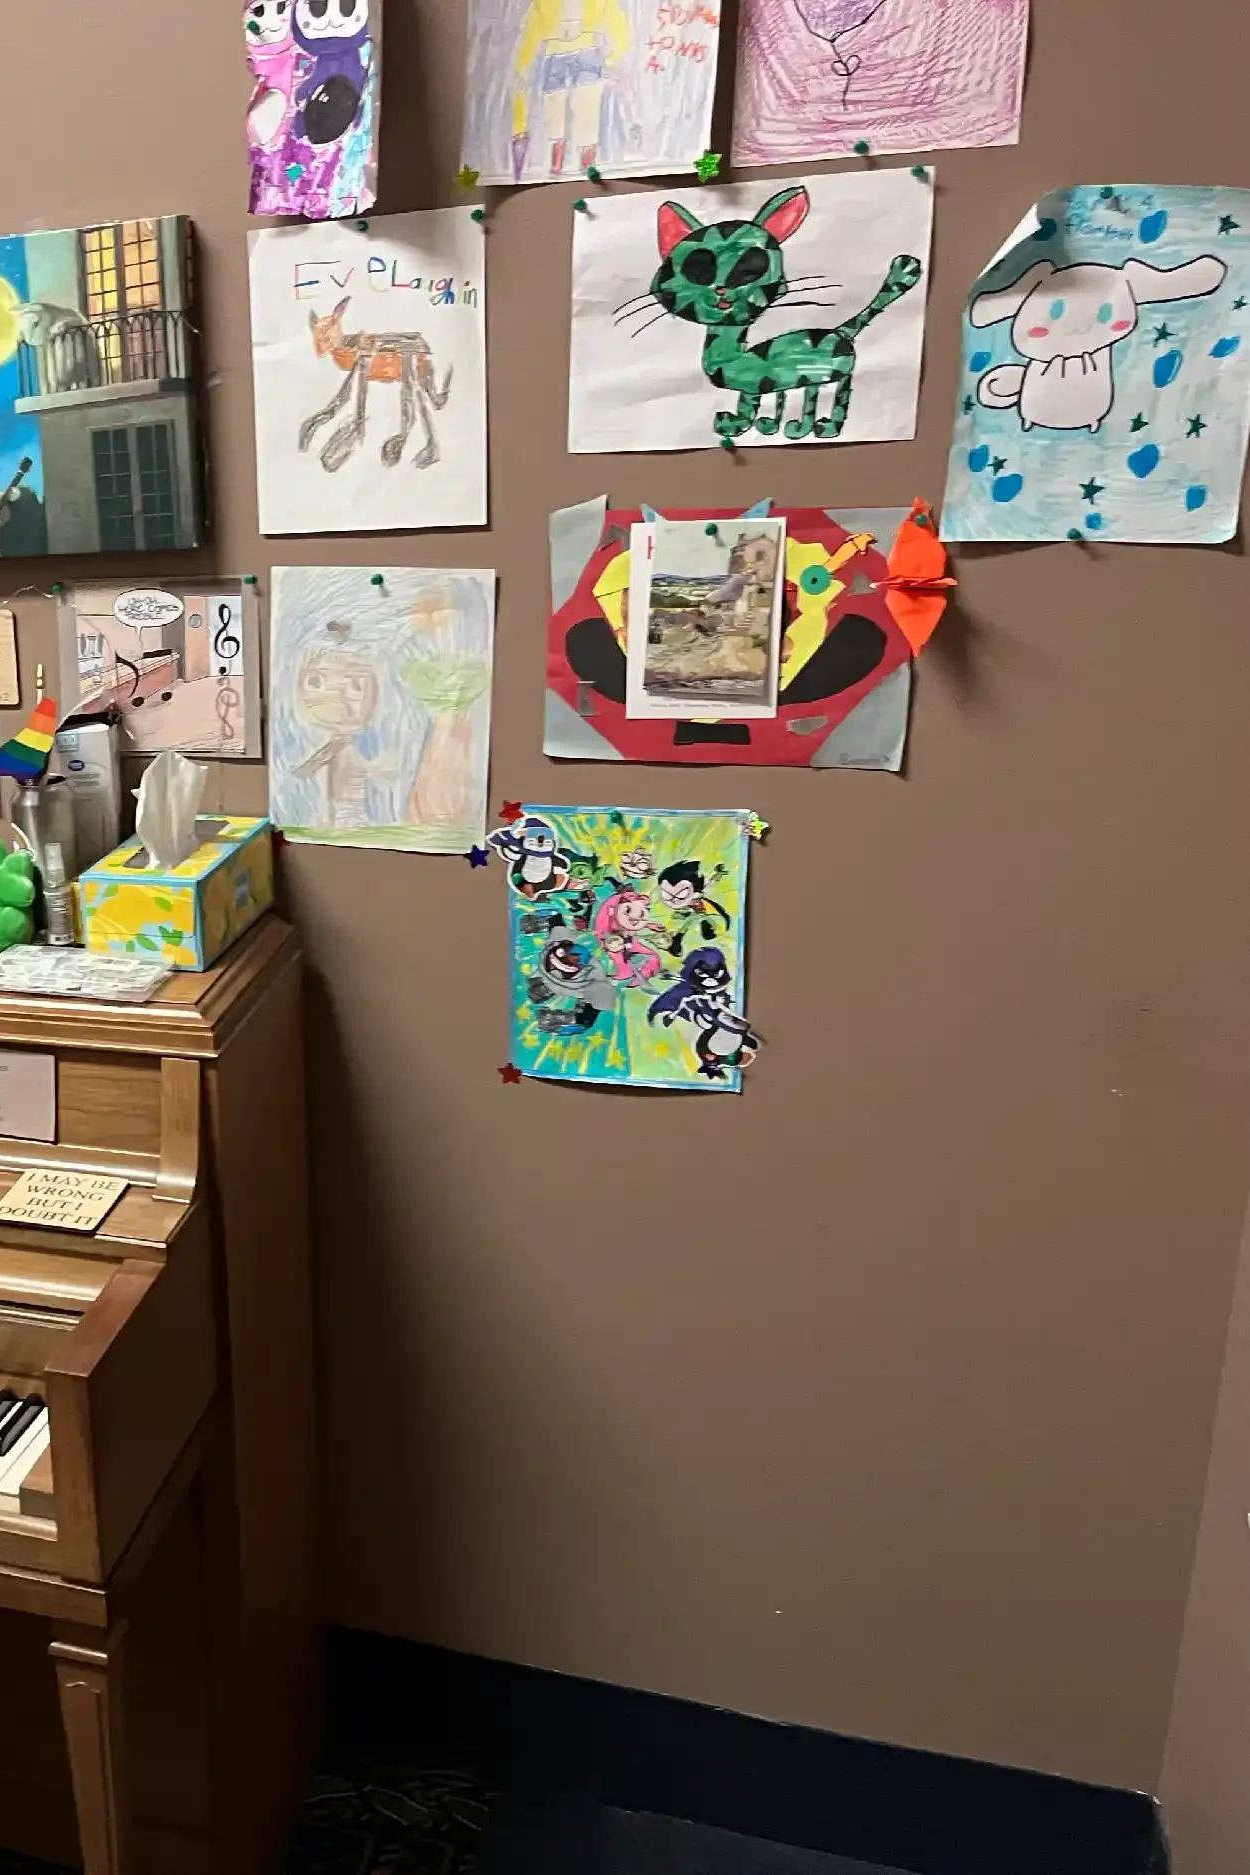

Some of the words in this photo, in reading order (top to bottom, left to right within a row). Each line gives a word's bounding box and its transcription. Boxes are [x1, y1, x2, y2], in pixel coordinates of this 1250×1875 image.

[27, 1172, 36, 1182] I
[40, 1174, 88, 1188] MAY
[91, 1180, 120, 1191] BE
[27, 1185, 105, 1201] WRONG
[26, 1197, 73, 1209] BUT
[74, 1203, 83, 1211] I
[73, 1216, 99, 1226] IT
